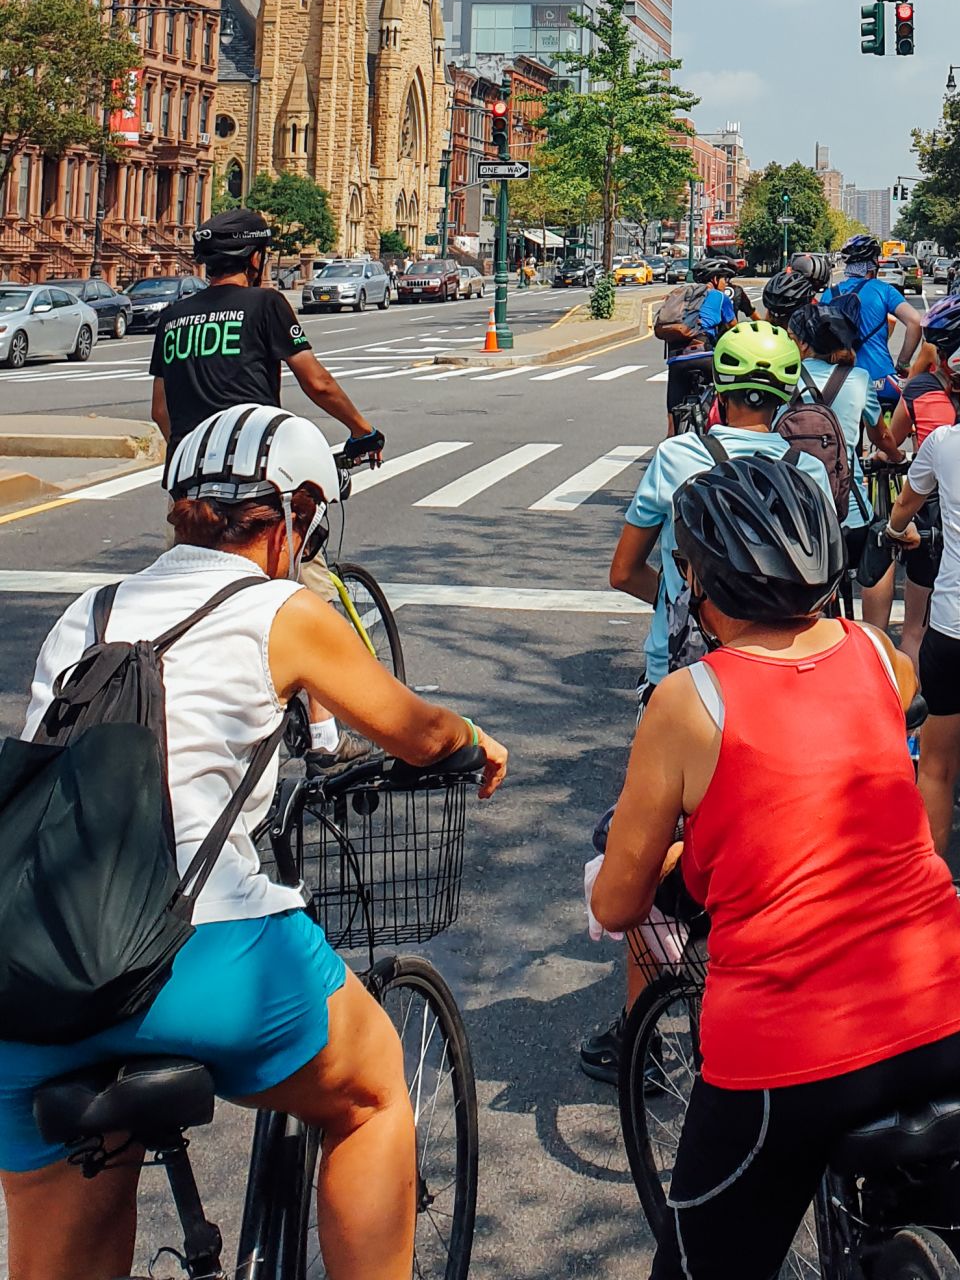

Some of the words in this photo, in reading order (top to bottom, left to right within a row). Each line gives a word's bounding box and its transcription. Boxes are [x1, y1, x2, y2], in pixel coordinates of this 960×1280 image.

[507, 166, 523, 174] WAY
[165, 314, 207, 332] UNLIMITED
[209, 310, 245, 321] BIKING
[163, 321, 243, 365] GUIDE
